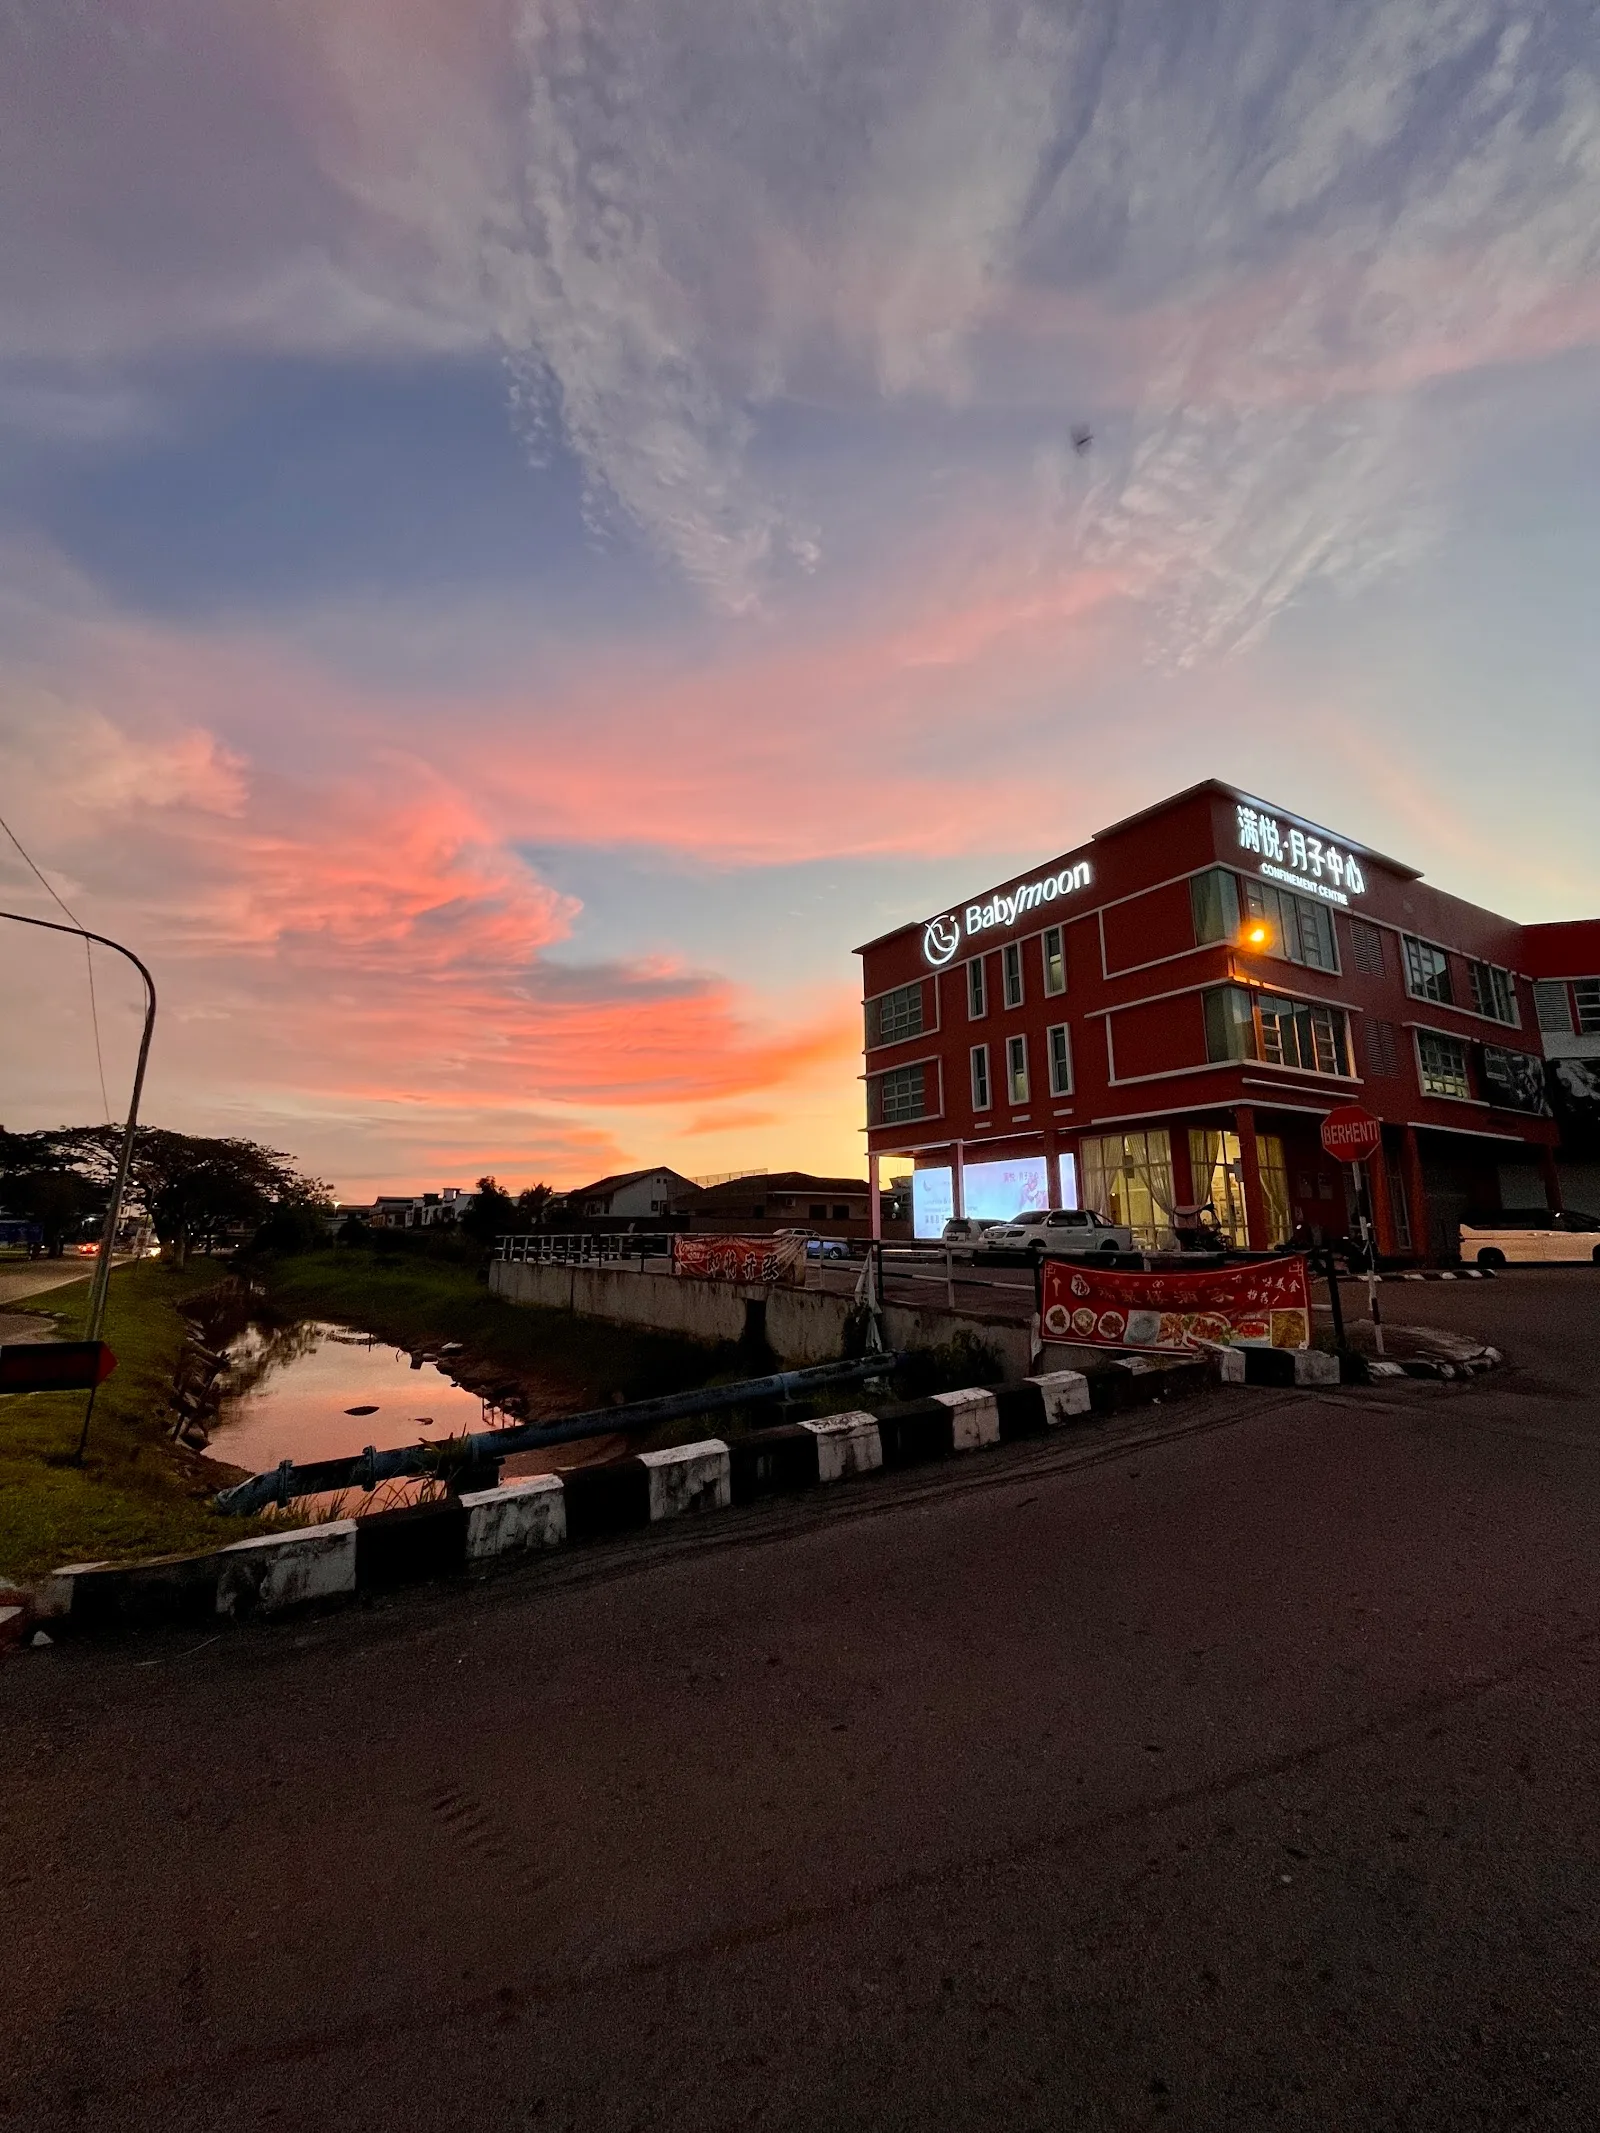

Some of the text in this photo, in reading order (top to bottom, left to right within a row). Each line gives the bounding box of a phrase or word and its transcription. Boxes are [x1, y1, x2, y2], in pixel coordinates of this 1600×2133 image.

[1236, 805, 1365, 894] 满悦·月子中心
[965, 861, 1090, 935] Babymoon
[1260, 863, 1348, 906] CONFINEMENT CENTRE
[1323, 1120, 1378, 1145] BERHENTI
